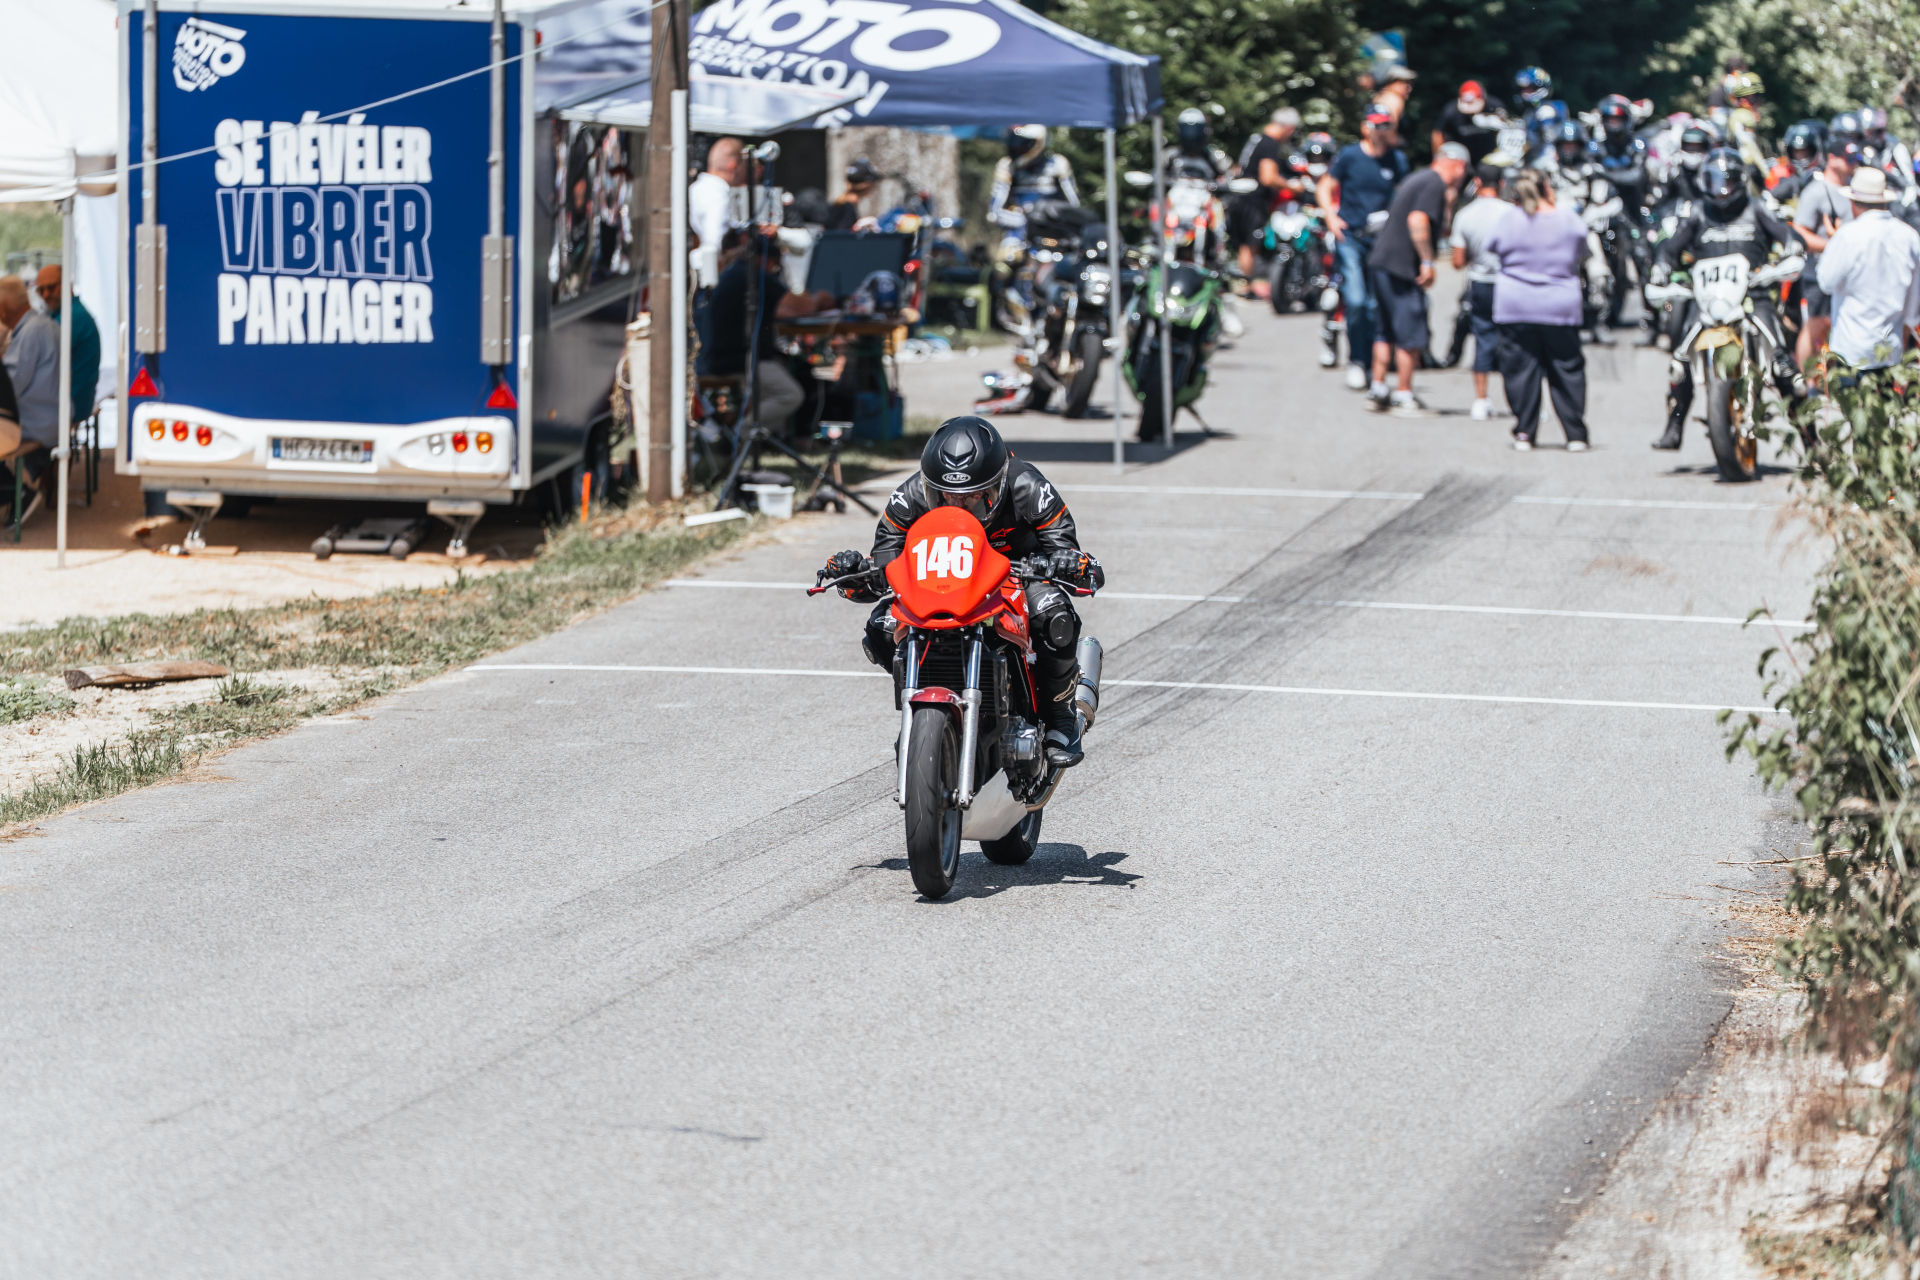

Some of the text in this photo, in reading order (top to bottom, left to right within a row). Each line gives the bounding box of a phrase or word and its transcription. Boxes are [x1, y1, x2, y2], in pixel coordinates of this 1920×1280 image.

[175, 23, 246, 77] MOTO
[693, 0, 1001, 71] MOTO
[214, 110, 432, 187] SE RÉVÉLER
[215, 184, 433, 282] VIBRER
[217, 273, 434, 345] PARTAGER
[911, 535, 974, 581] 146
